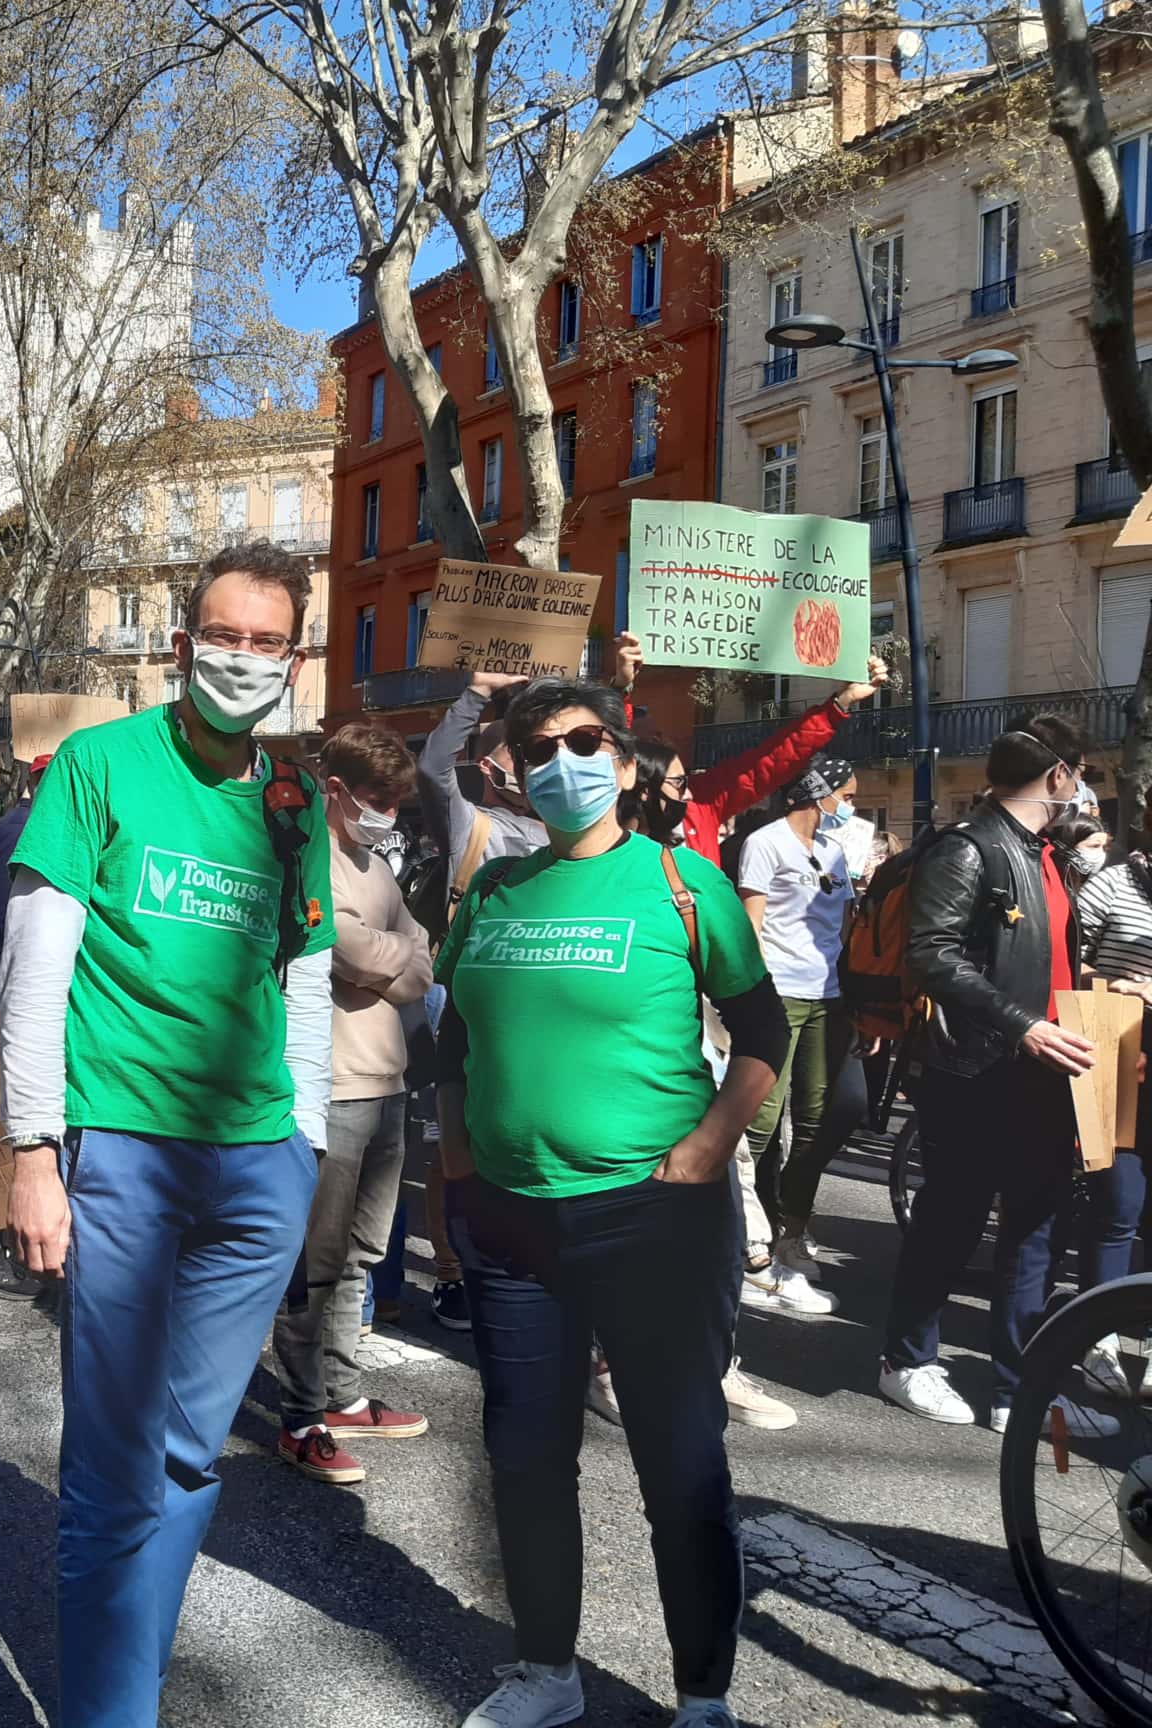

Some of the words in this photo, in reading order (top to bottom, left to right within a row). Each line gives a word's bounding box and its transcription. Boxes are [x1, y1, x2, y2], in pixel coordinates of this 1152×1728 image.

[774, 538, 798, 561] DE
[811, 545, 836, 566] LA
[436, 583, 469, 602] PLUS
[474, 569, 539, 594] MACRON
[543, 578, 588, 598] BRASSE
[487, 637, 533, 660] MACRON
[181, 859, 268, 902] Toulouse
[499, 922, 605, 940] Toulouse
[605, 932, 621, 941] en
[489, 941, 614, 963] Transition
